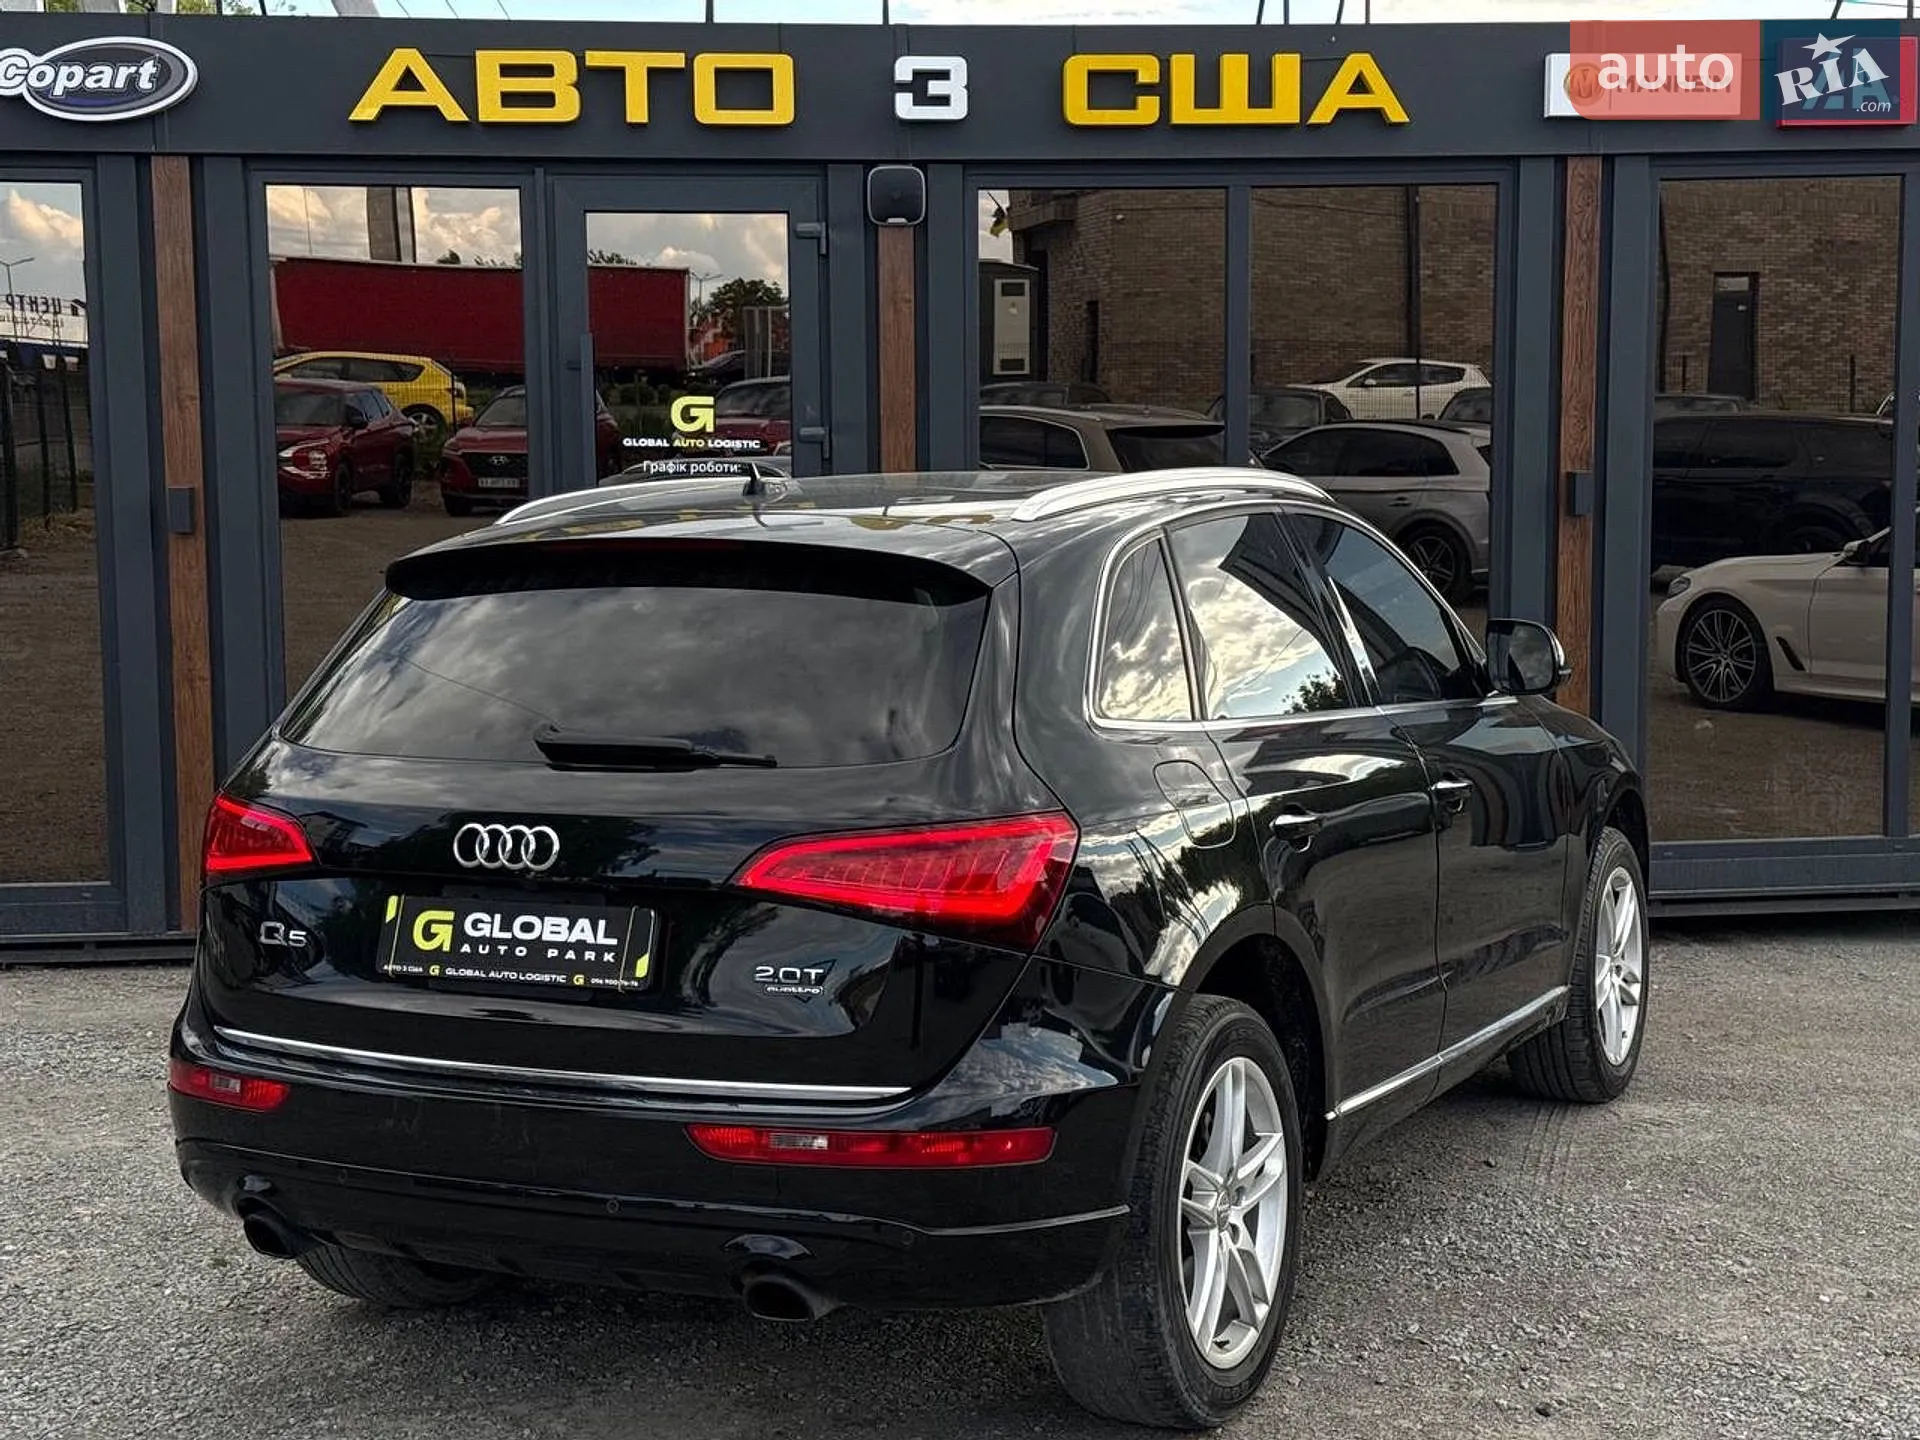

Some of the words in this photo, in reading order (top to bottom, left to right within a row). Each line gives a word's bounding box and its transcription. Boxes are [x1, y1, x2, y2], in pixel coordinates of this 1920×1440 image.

[0, 55, 157, 96] Copart
[348, 48, 795, 125] АВТО
[1063, 53, 1411, 126] США
[622, 437, 670, 447] GLOBAL
[672, 439, 705, 448] AUTO
[707, 439, 761, 449] LOGISTIC
[643, 460, 688, 475] Графік
[690, 461, 742, 475] роботи:
[260, 921, 307, 947] Q5
[464, 911, 618, 945] GLOBAL
[460, 943, 528, 957] AUTO
[547, 948, 616, 963] PARK
[445, 967, 487, 978] GLOBAL
[488, 970, 518, 981] AUTO
[519, 972, 567, 984] LOGISTIC
[755, 966, 824, 985] 2.0T
